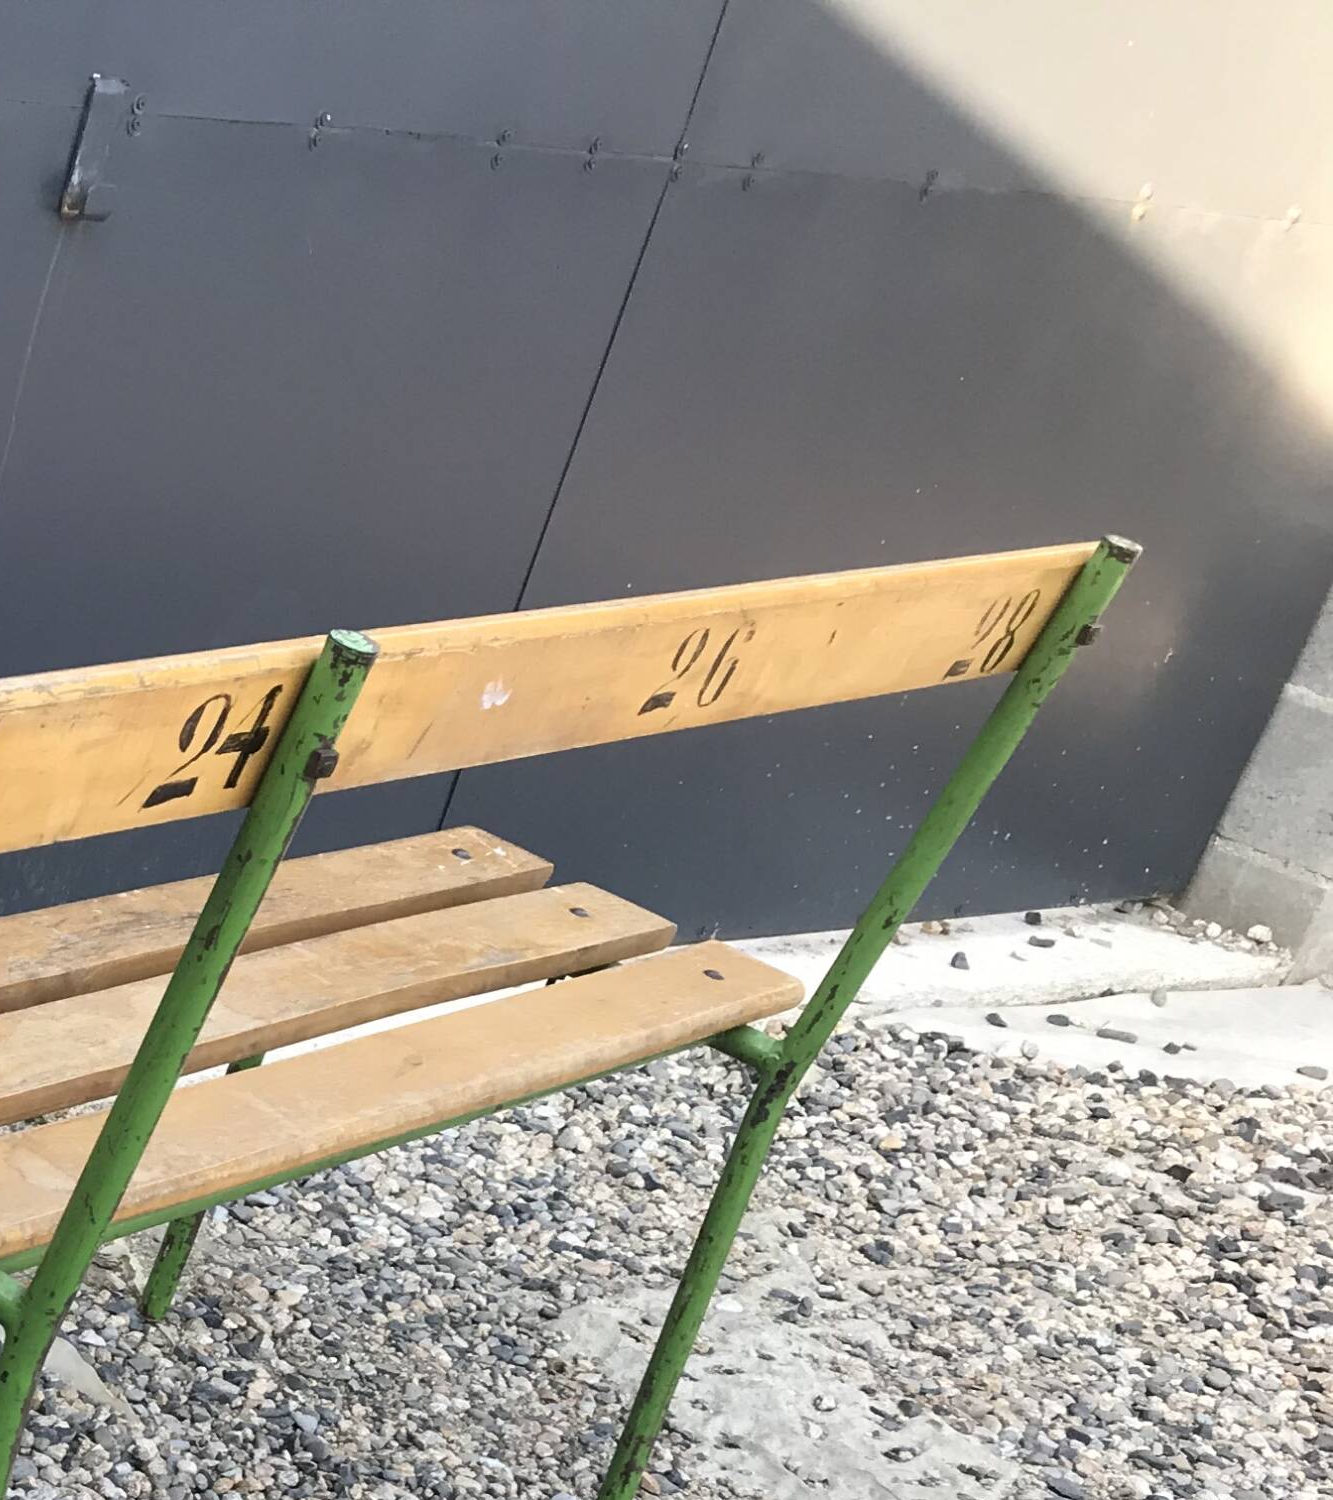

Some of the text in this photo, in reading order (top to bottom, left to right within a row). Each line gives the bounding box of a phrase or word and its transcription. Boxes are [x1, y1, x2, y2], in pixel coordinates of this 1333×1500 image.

[637, 620, 756, 716] 26
[941, 588, 1041, 680] 28
[138, 683, 283, 812] 24
